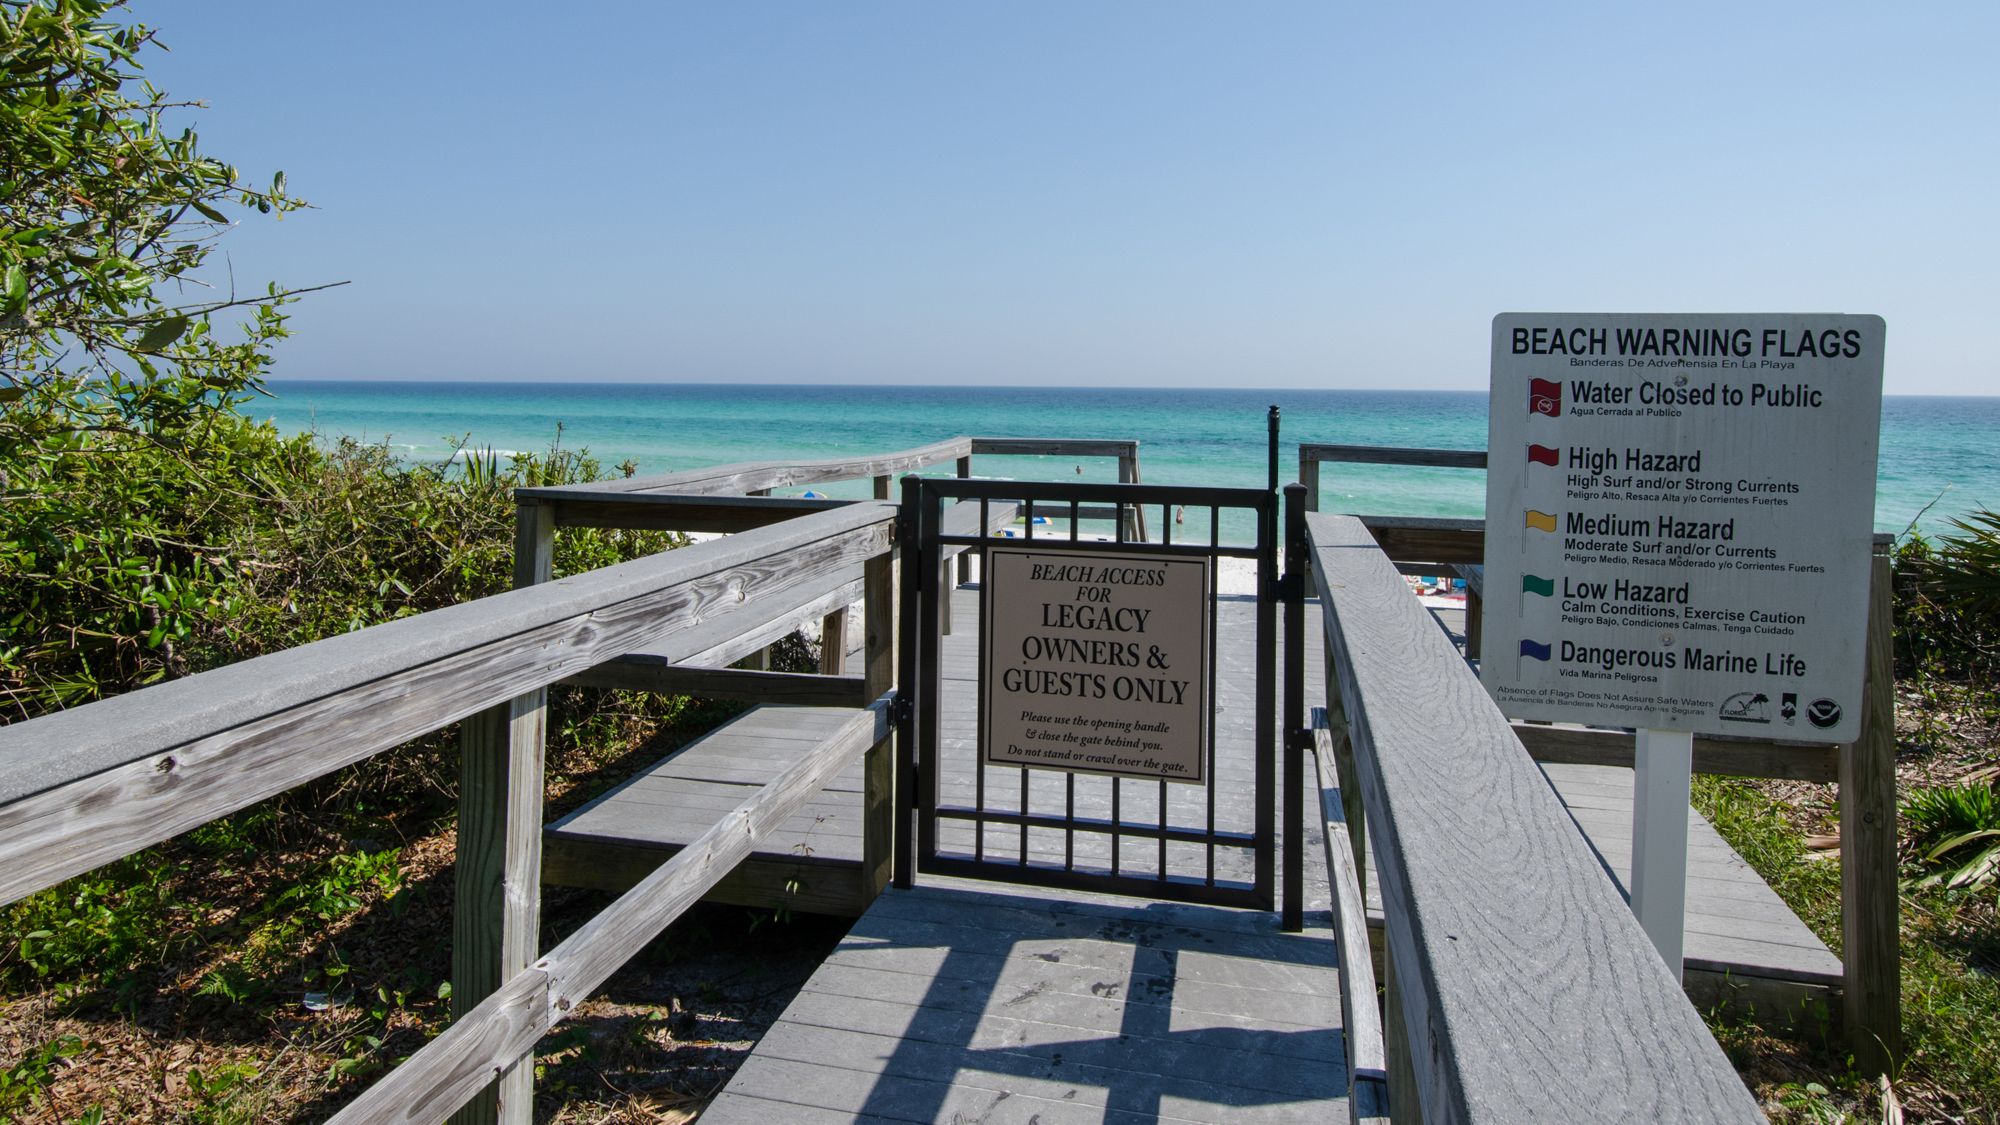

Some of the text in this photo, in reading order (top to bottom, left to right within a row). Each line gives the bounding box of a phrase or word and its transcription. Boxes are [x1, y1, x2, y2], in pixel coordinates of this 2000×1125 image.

[1512, 328, 1861, 358] BEACH WARNING FLAGS
[1570, 358, 1794, 370] Banderas De Advertensia En La Playa
[1571, 381, 1822, 407] Water Closed to Public
[1570, 407, 1681, 417] Agua Cerrada al Publico
[1569, 447, 1699, 474] High Hazard
[1567, 475, 1799, 494] High Surf and/or Strong Currents
[1567, 490, 1788, 505] Peligro Alto, Resaca Alta y/o Corrientes Fuertes
[1566, 512, 1734, 540] Medium Hazard
[1565, 538, 1776, 558] Moderate Surf and/or Currents
[1030, 563, 1165, 587] BEACH ACCESS
[1565, 554, 1824, 573] Peligro Medio, Resaca Moderado y/o Corrientes Fuertes
[1075, 586, 1111, 603] FOR
[1564, 576, 1689, 603] Low Hazard
[1041, 603, 1151, 633] LEGACY
[1562, 601, 1805, 624] Calm Conditions, Exercise Caution
[1562, 615, 1794, 635] Peligro Bajo, Condiciones Calmas, Tenga Cuidado
[1022, 636, 1170, 670] OWNERS &
[1561, 640, 1806, 676] Dangerous Marine Life
[1003, 668, 1190, 705] GUESTS ONLY
[1560, 669, 1657, 683] Vida Marina Peligrosa
[1497, 686, 1714, 707] Absence of Flags Does Not Assure Safe Waters
[1509, 696, 1544, 704] Ausencia
[1558, 699, 1594, 707] Banderas
[1609, 702, 1642, 711] Asegura
[1671, 707, 1704, 716] Seguras
[1021, 711, 1170, 733] Please use the opening handle
[1026, 729, 1164, 752] & close the gate behind you.
[1007, 744, 1187, 773] Do not stand or crawl over the gate.
